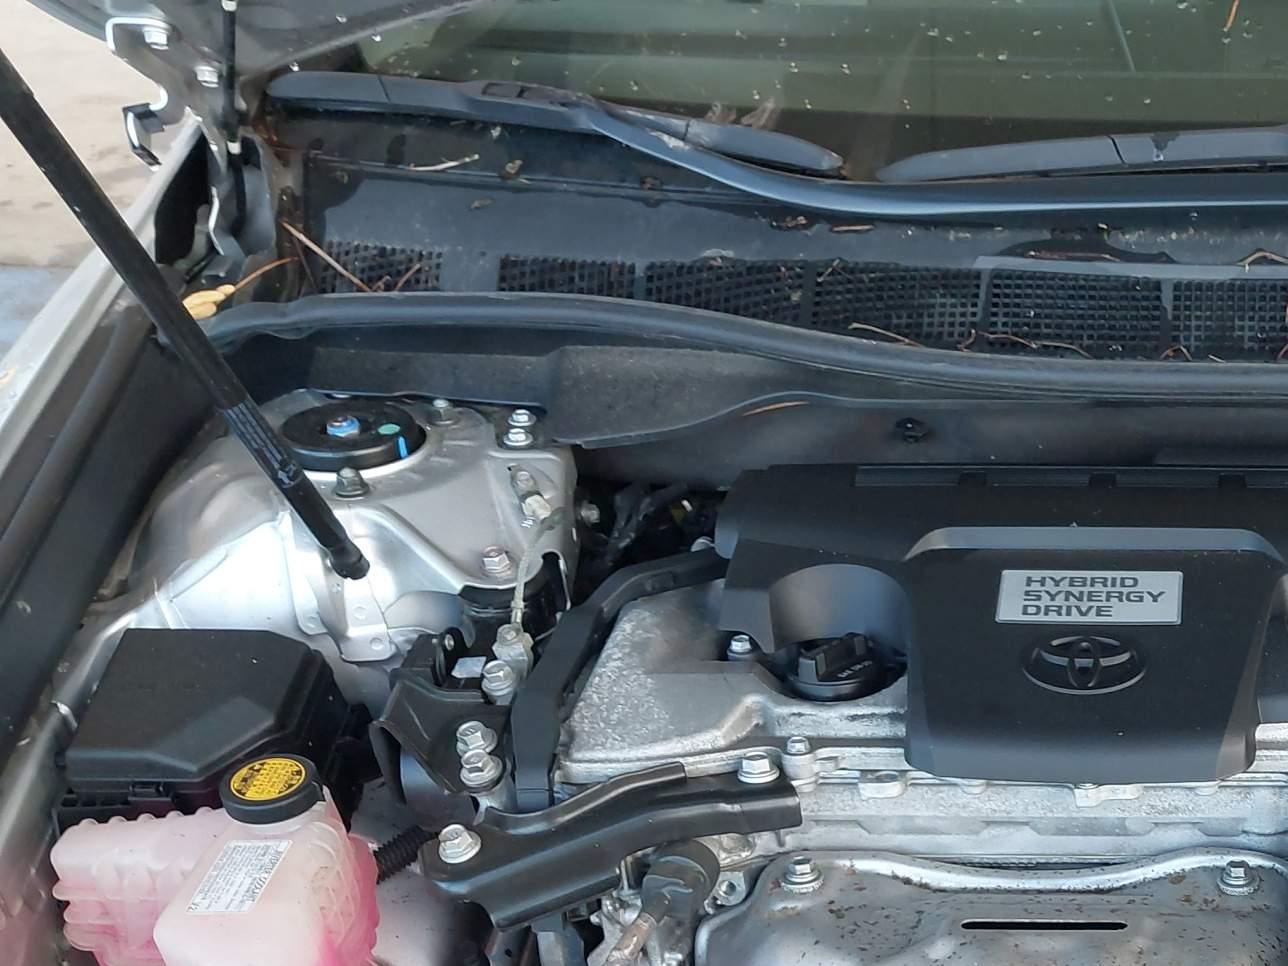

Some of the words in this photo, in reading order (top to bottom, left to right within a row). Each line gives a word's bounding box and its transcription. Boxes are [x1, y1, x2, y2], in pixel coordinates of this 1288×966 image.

[1025, 576, 1138, 588] HYBRID
[1023, 590, 1166, 603] SYNERGY
[1021, 604, 1114, 617] DRIVE
